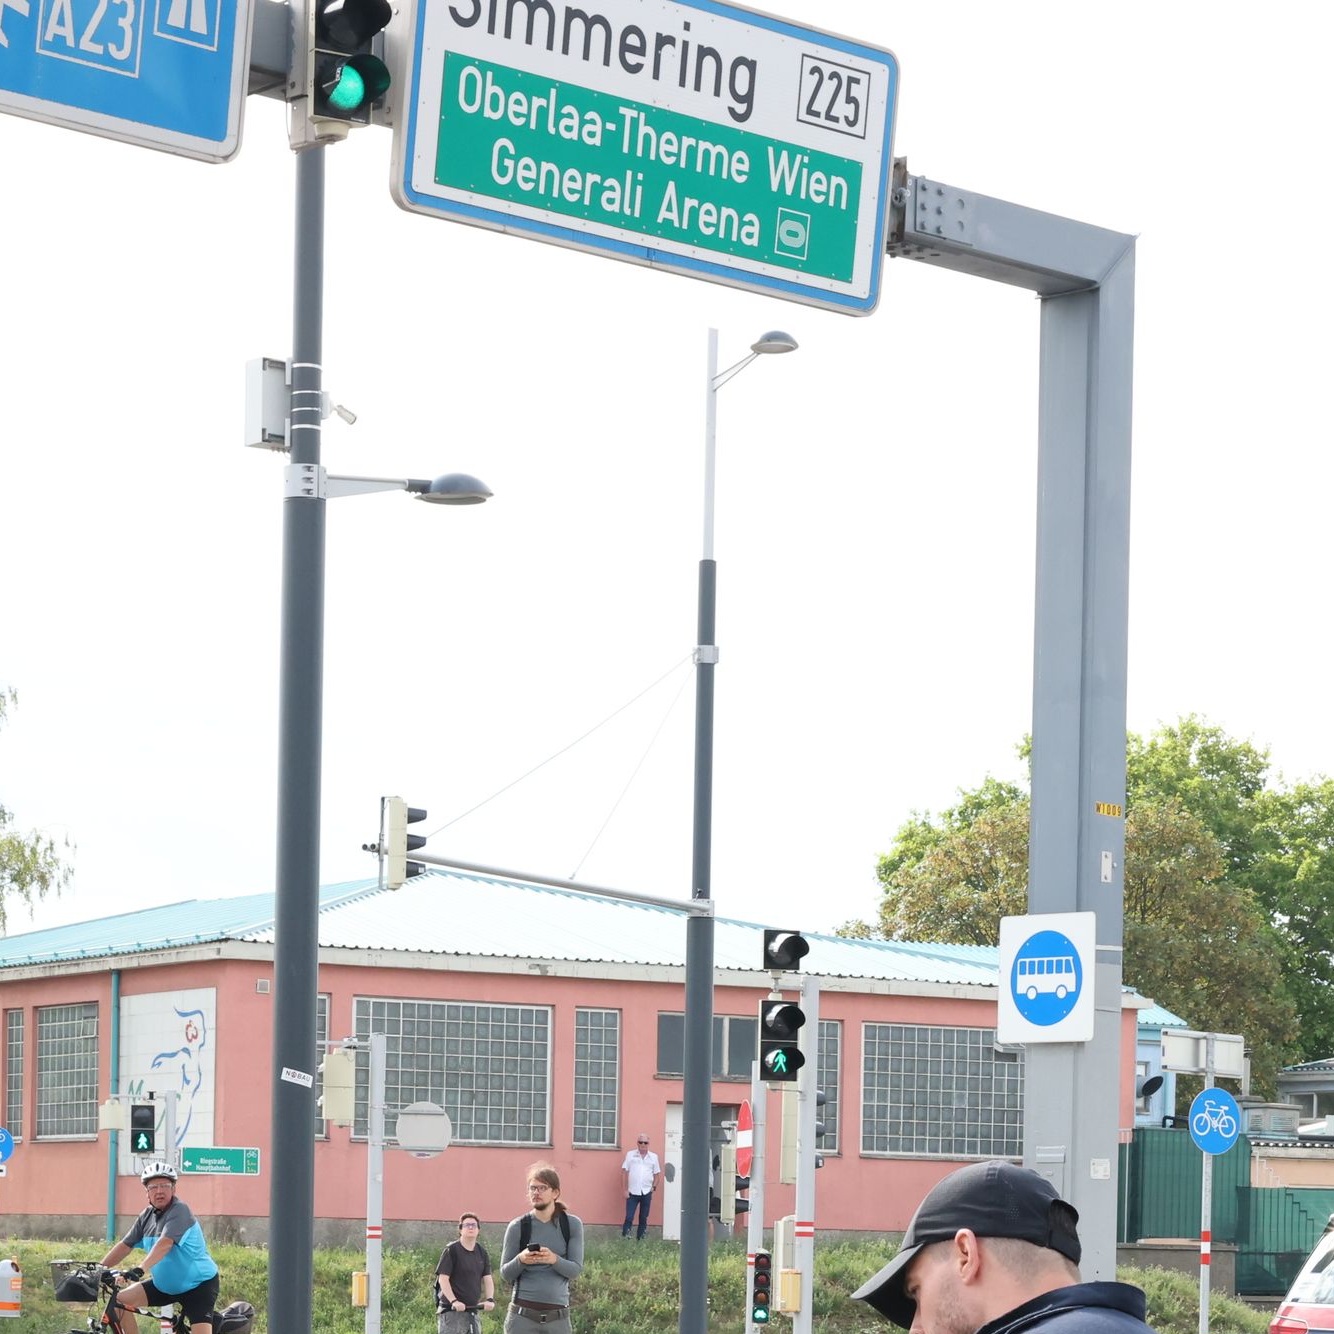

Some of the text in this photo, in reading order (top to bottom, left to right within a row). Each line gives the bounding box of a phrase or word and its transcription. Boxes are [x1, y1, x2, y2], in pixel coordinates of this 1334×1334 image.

[44, 0, 134, 60] A23
[457, 65, 849, 210] Oberlaa-Therme Wien
[806, 65, 861, 128] 225
[491, 137, 760, 247] Generali Arena
